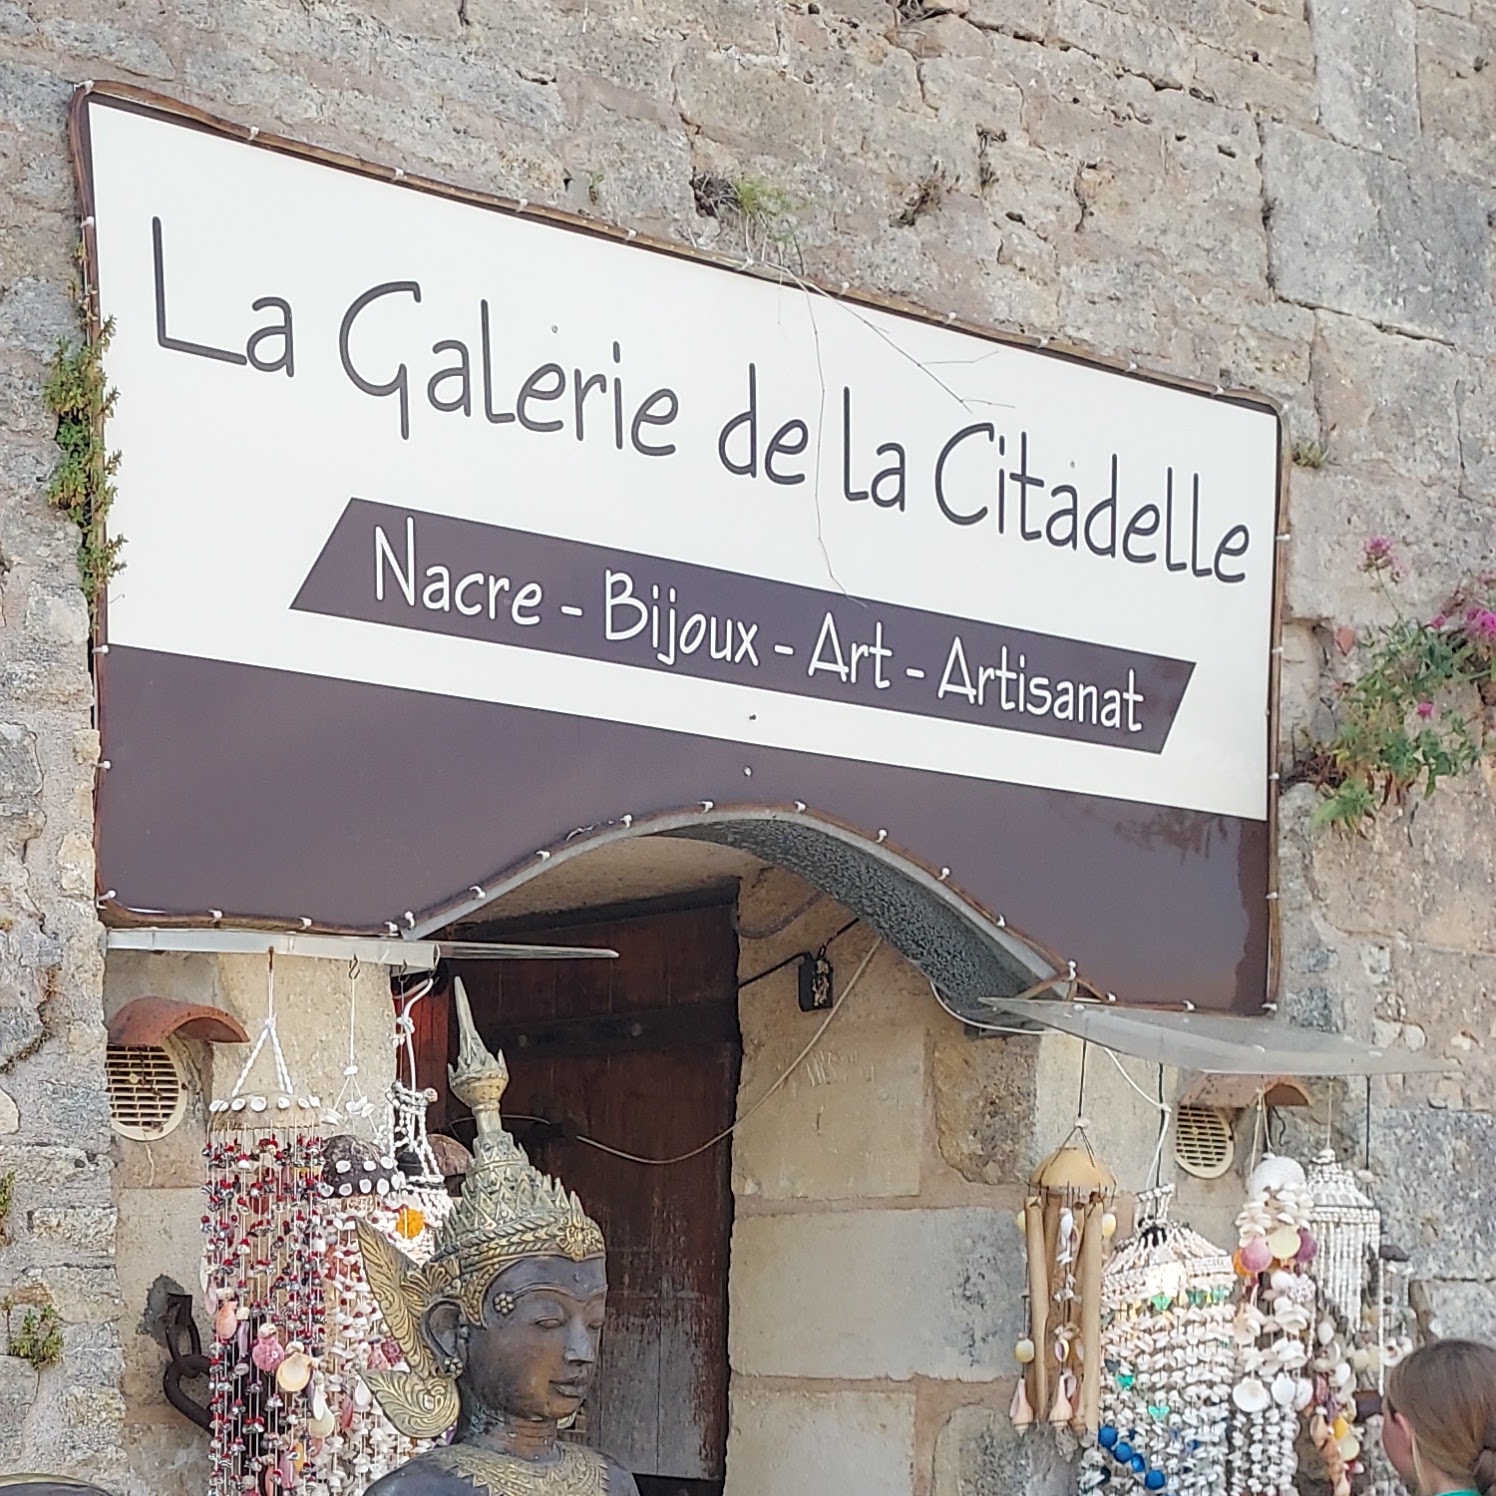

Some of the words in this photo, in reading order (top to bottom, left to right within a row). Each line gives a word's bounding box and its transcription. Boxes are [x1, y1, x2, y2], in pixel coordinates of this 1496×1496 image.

[152, 216, 295, 378] La
[338, 280, 679, 457] Galerie
[718, 362, 809, 486] de
[843, 386, 906, 512] la
[934, 422, 1250, 584] Citadelle
[375, 517, 542, 625] Nacre
[605, 569, 759, 666] Bijoux
[808, 612, 893, 689] Art
[937, 636, 1144, 732] Artisanat
